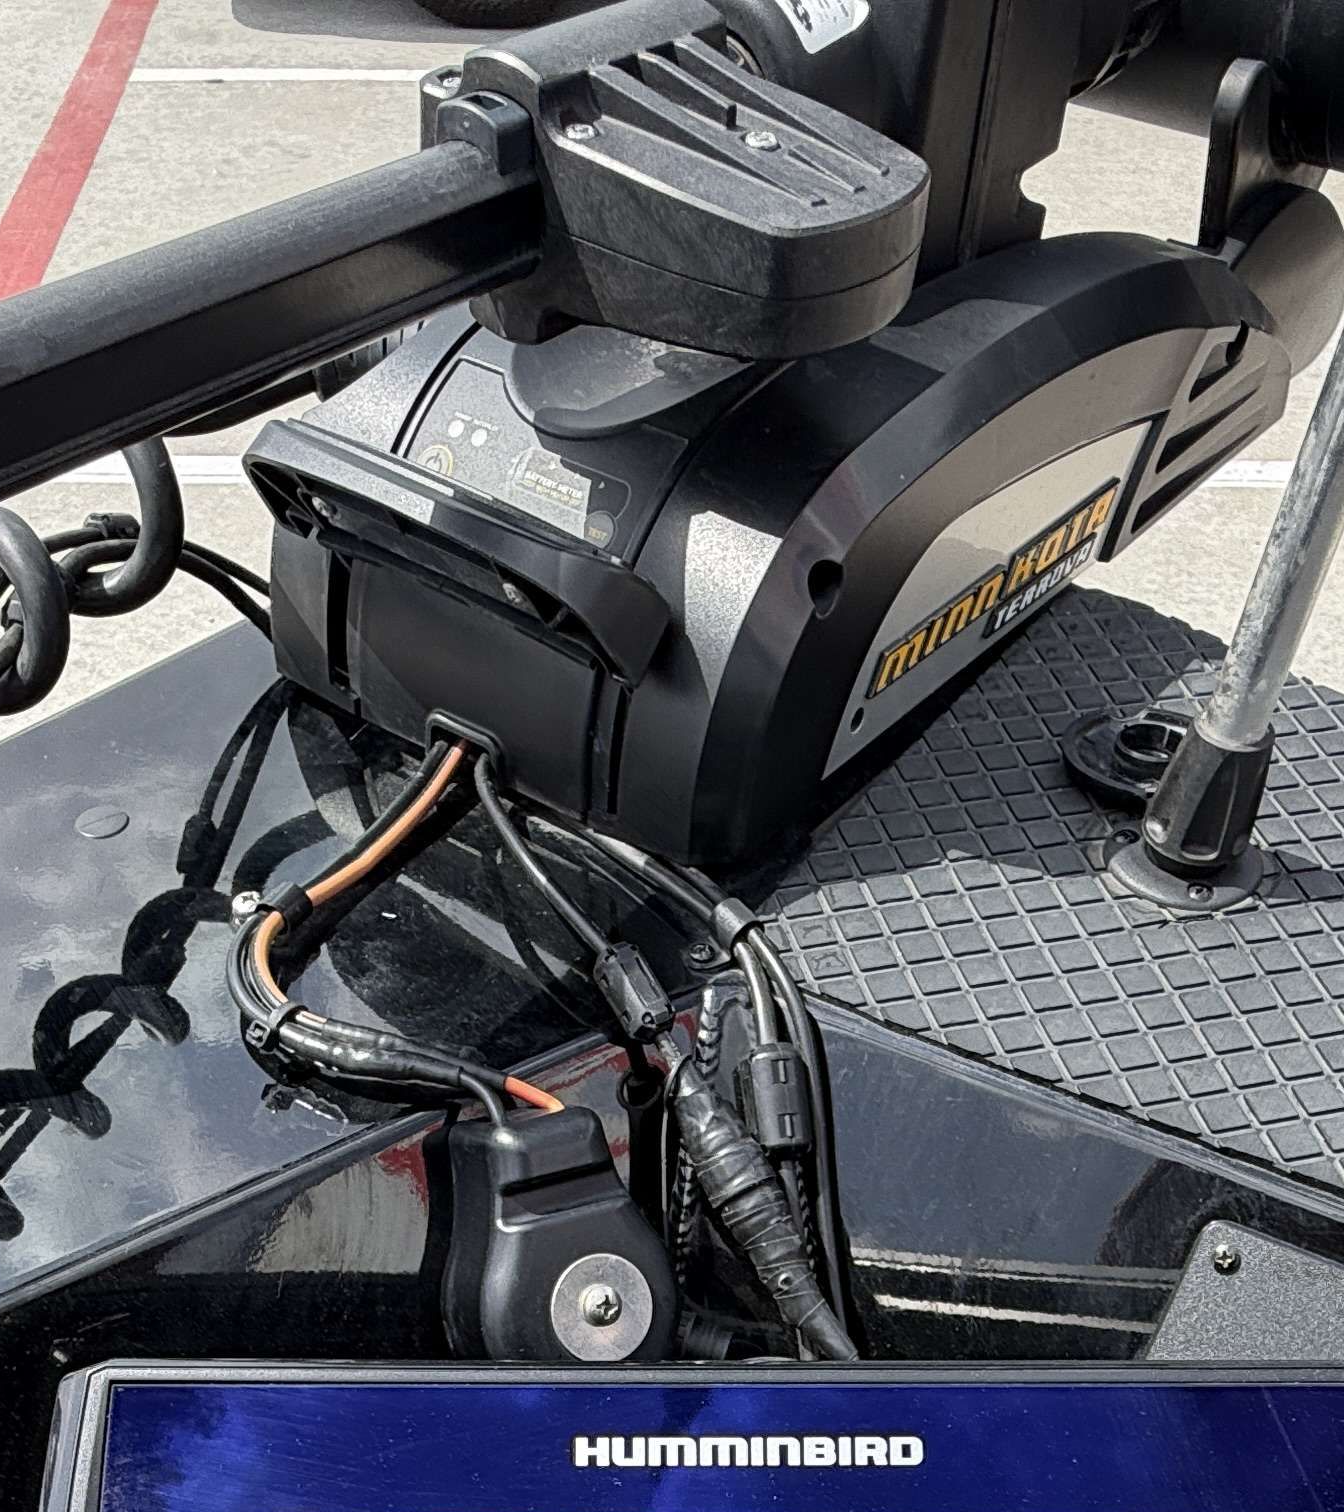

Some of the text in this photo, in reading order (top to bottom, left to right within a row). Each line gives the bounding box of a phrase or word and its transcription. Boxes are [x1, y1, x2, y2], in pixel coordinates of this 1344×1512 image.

[993, 539, 1093, 631] TERROVA
[1008, 487, 1118, 593] KOTA
[573, 1435, 925, 1468] HUMMINBIRD
